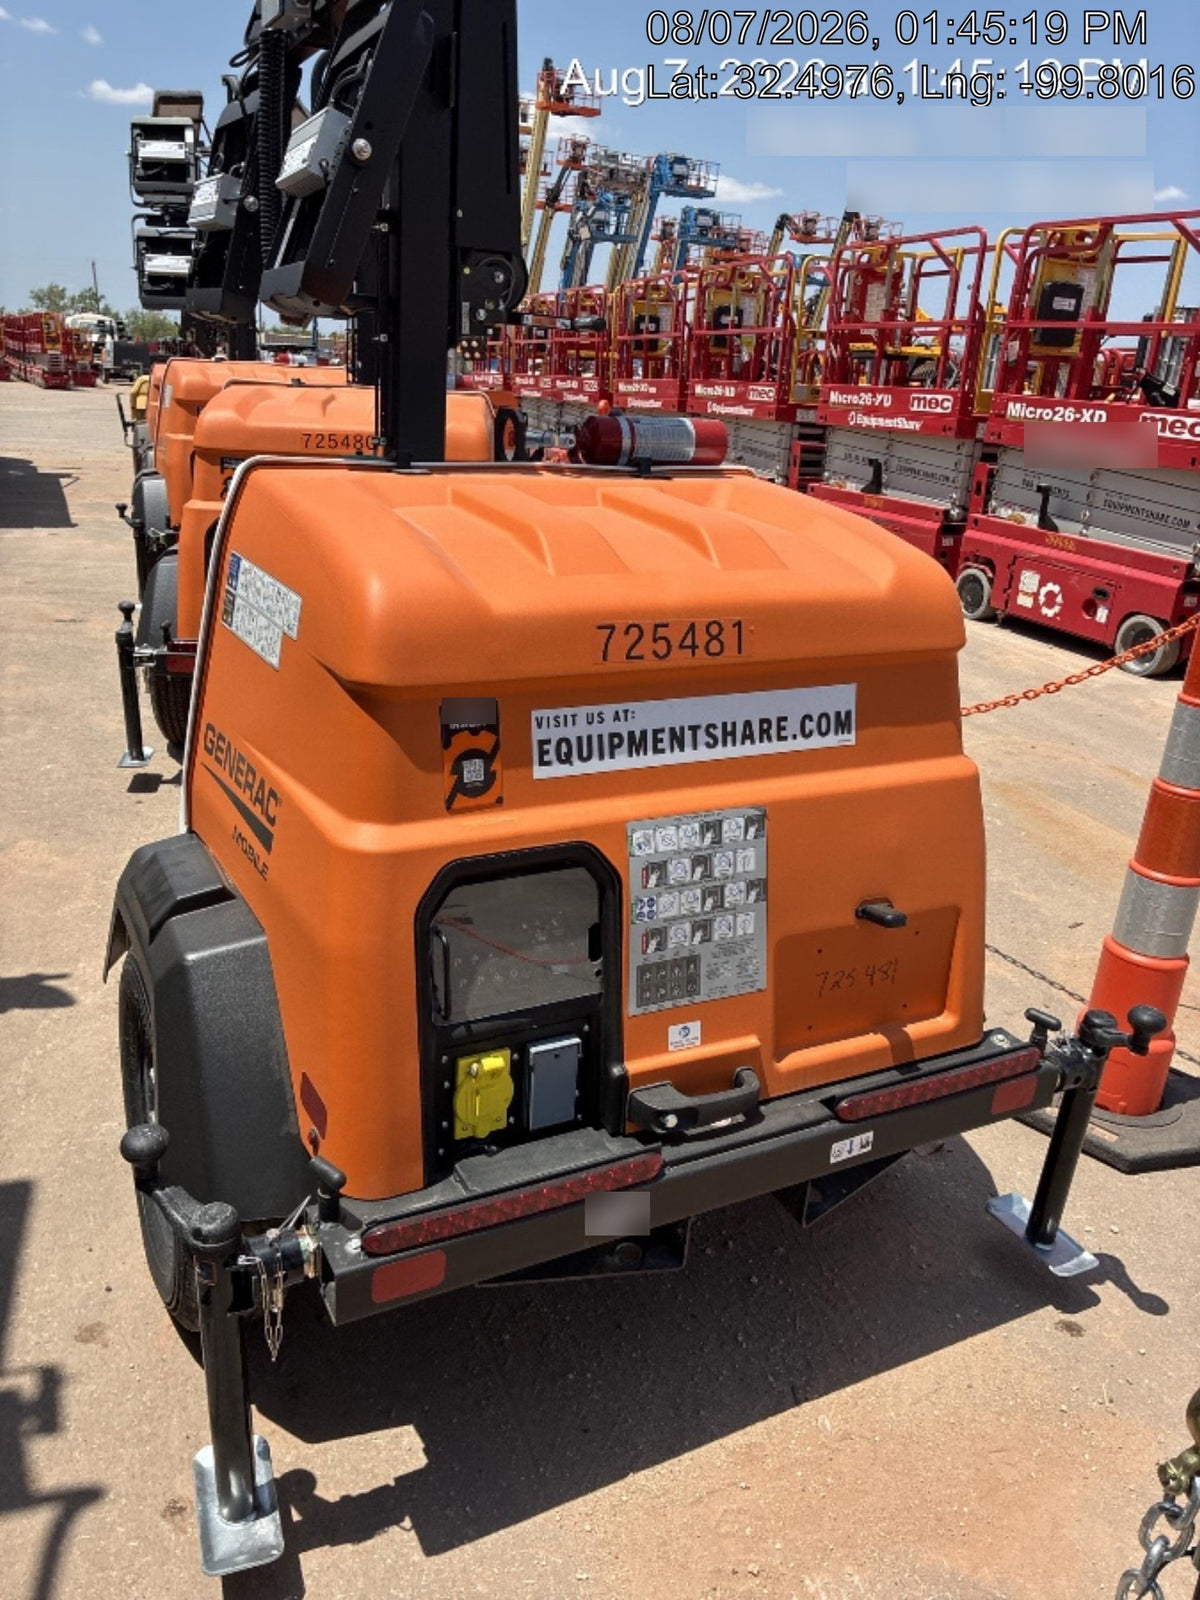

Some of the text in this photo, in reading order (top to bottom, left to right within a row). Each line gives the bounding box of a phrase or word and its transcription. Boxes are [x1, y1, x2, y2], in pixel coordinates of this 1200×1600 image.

[1006, 401, 1107, 423] Micro26-XD
[596, 620, 744, 662] 725481
[535, 709, 636, 730] VISIT US AT:
[536, 710, 853, 767] EQUIPMENTSHARE.COM
[203, 722, 279, 827] GENERAC
[232, 824, 269, 882] MOBILE
